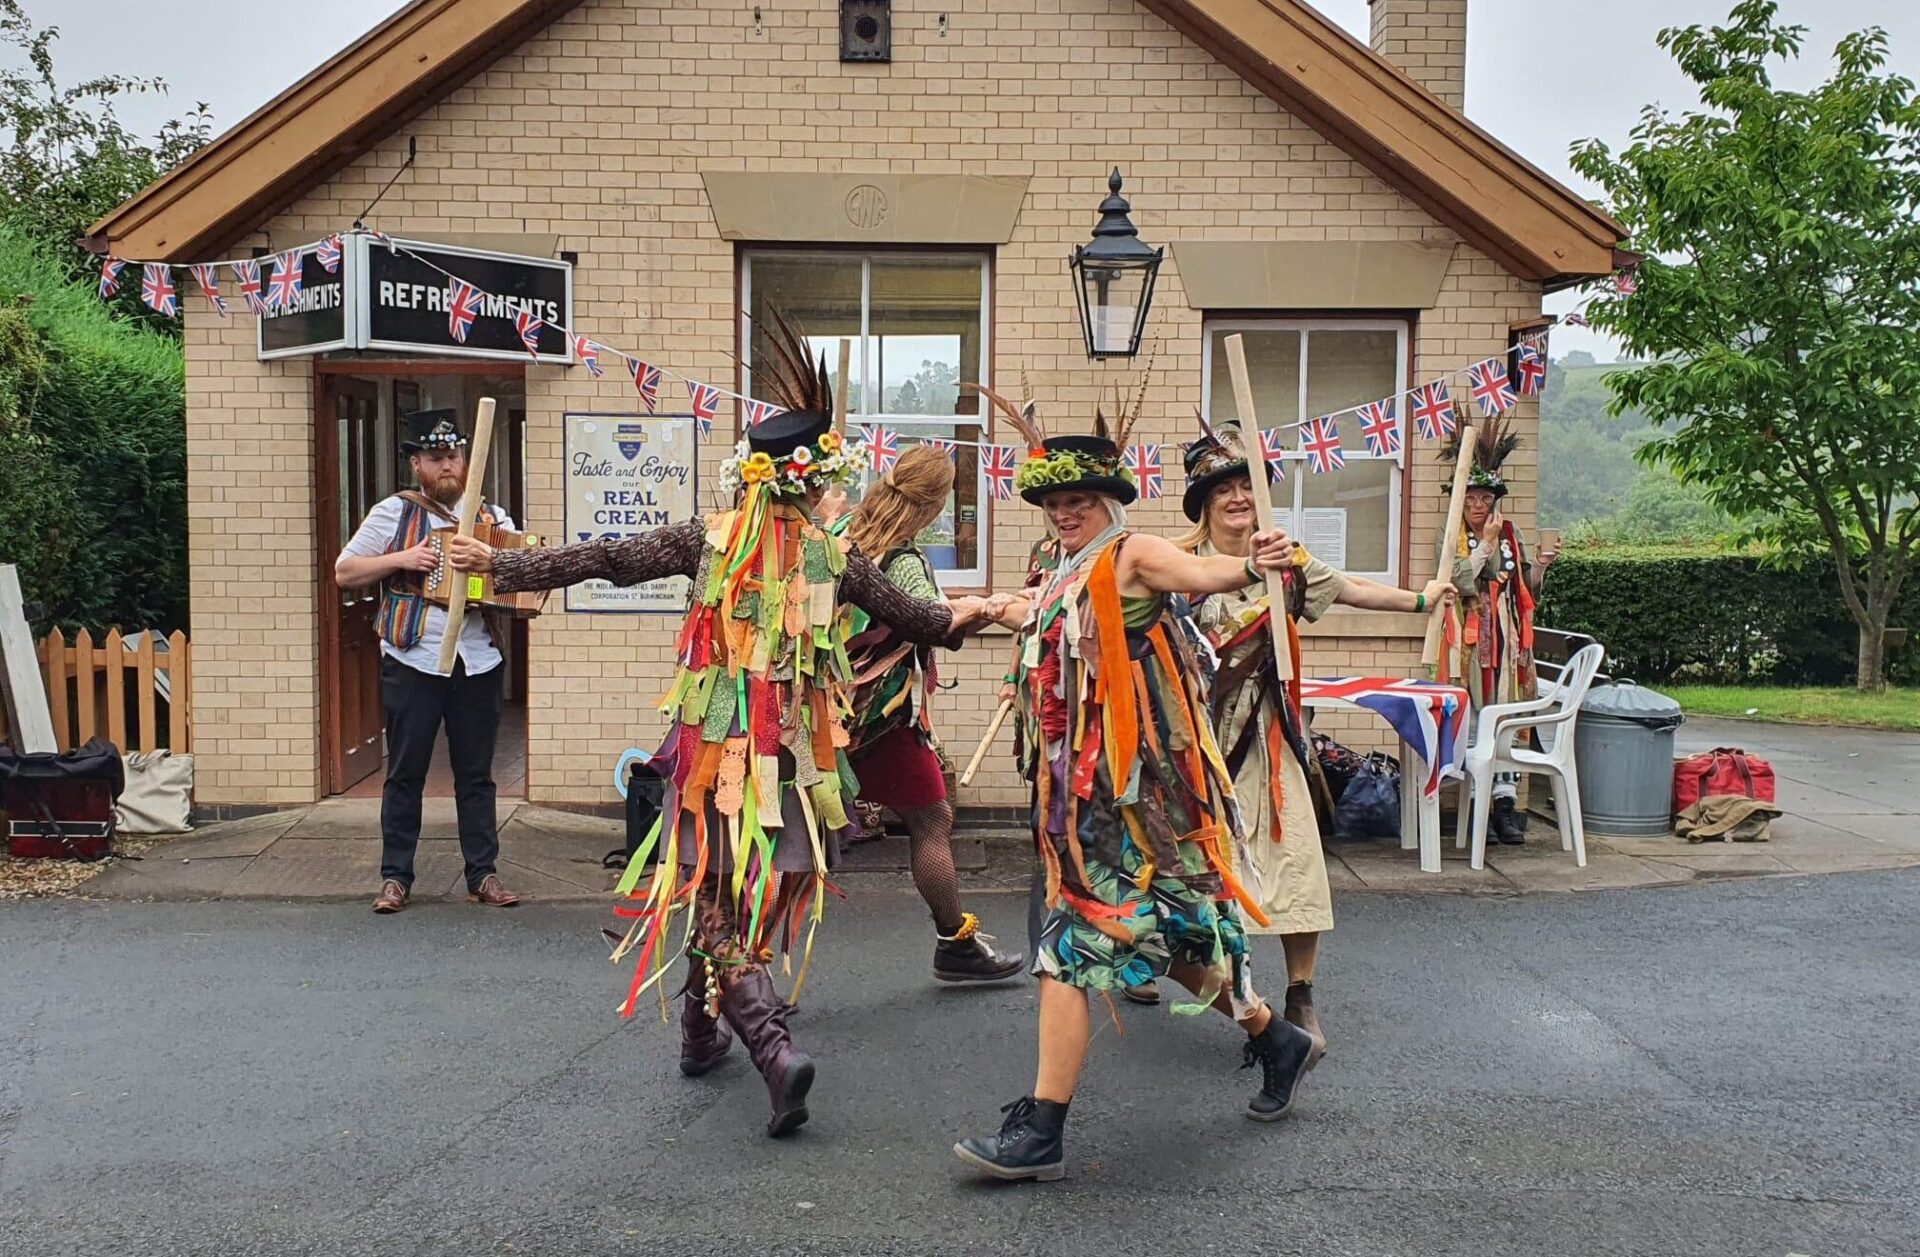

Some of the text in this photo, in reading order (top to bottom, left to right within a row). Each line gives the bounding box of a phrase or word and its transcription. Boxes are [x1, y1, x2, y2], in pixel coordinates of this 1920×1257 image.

[379, 280, 559, 323] REFREMENTS
[573, 452, 689, 485] Taste and Enjoy
[603, 490, 658, 506] REAL
[594, 510, 670, 525] CREAM
